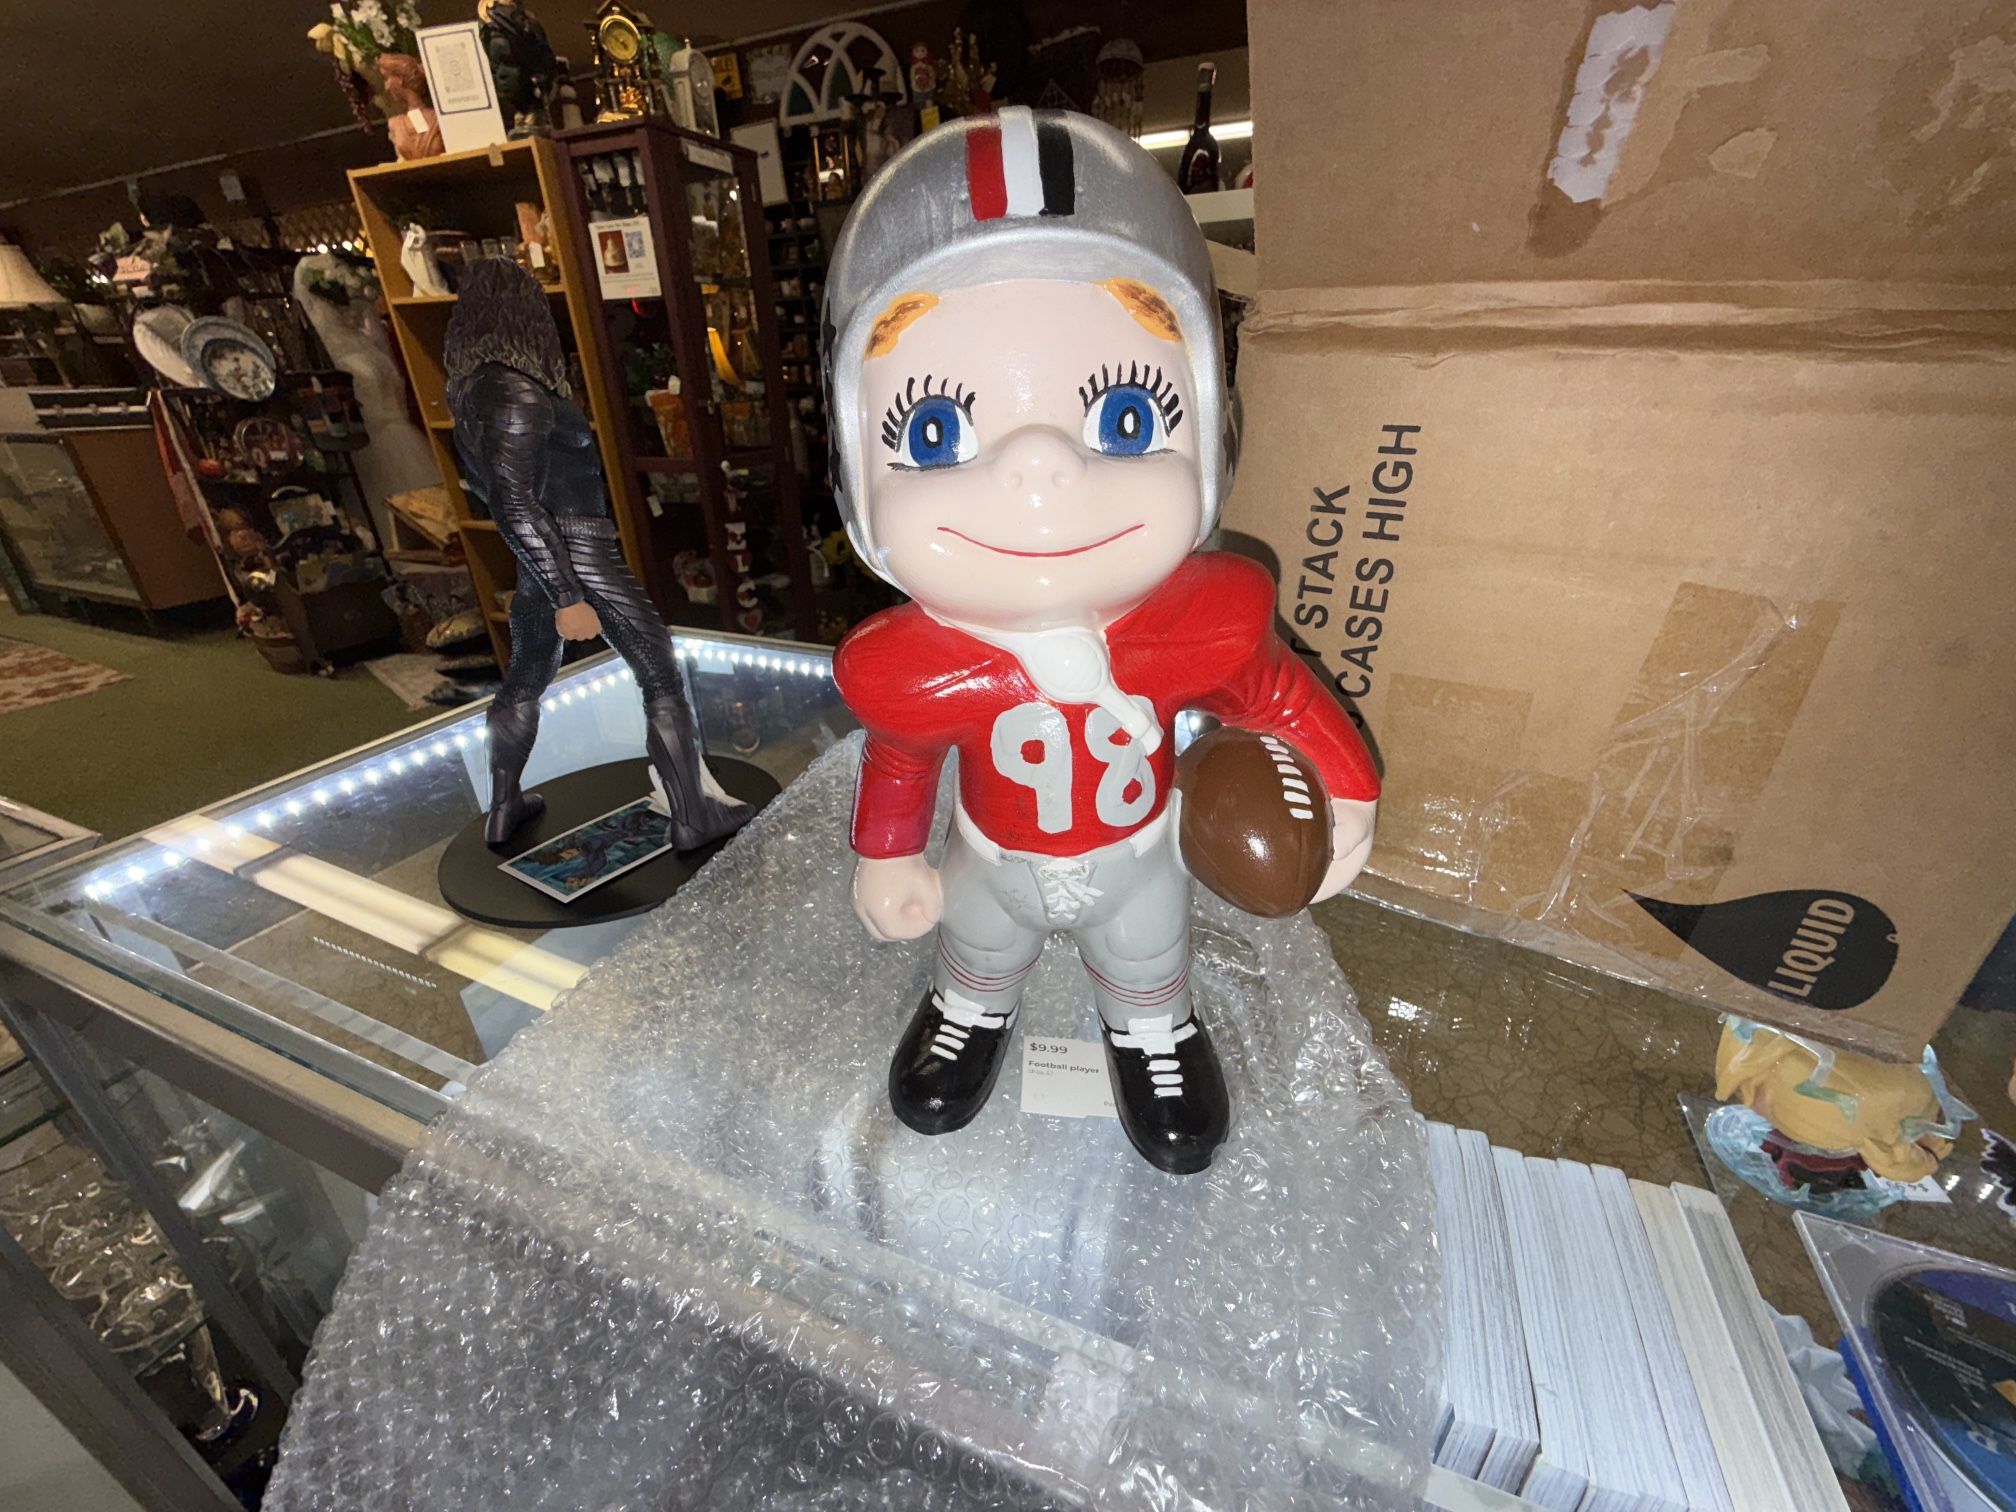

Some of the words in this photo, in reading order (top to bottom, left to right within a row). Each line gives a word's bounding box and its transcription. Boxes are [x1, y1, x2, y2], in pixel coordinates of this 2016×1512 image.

[1362, 424, 1421, 541] HIGH
[1294, 485, 1350, 629] STACK
[1335, 557, 1395, 698] CASES
[990, 695, 1164, 834] 98
[1767, 899, 1855, 997] LIQUID
[1028, 1060, 1067, 1071] Football
[1070, 1065, 1100, 1074] player
[1029, 1042, 1068, 1054] $9.99
